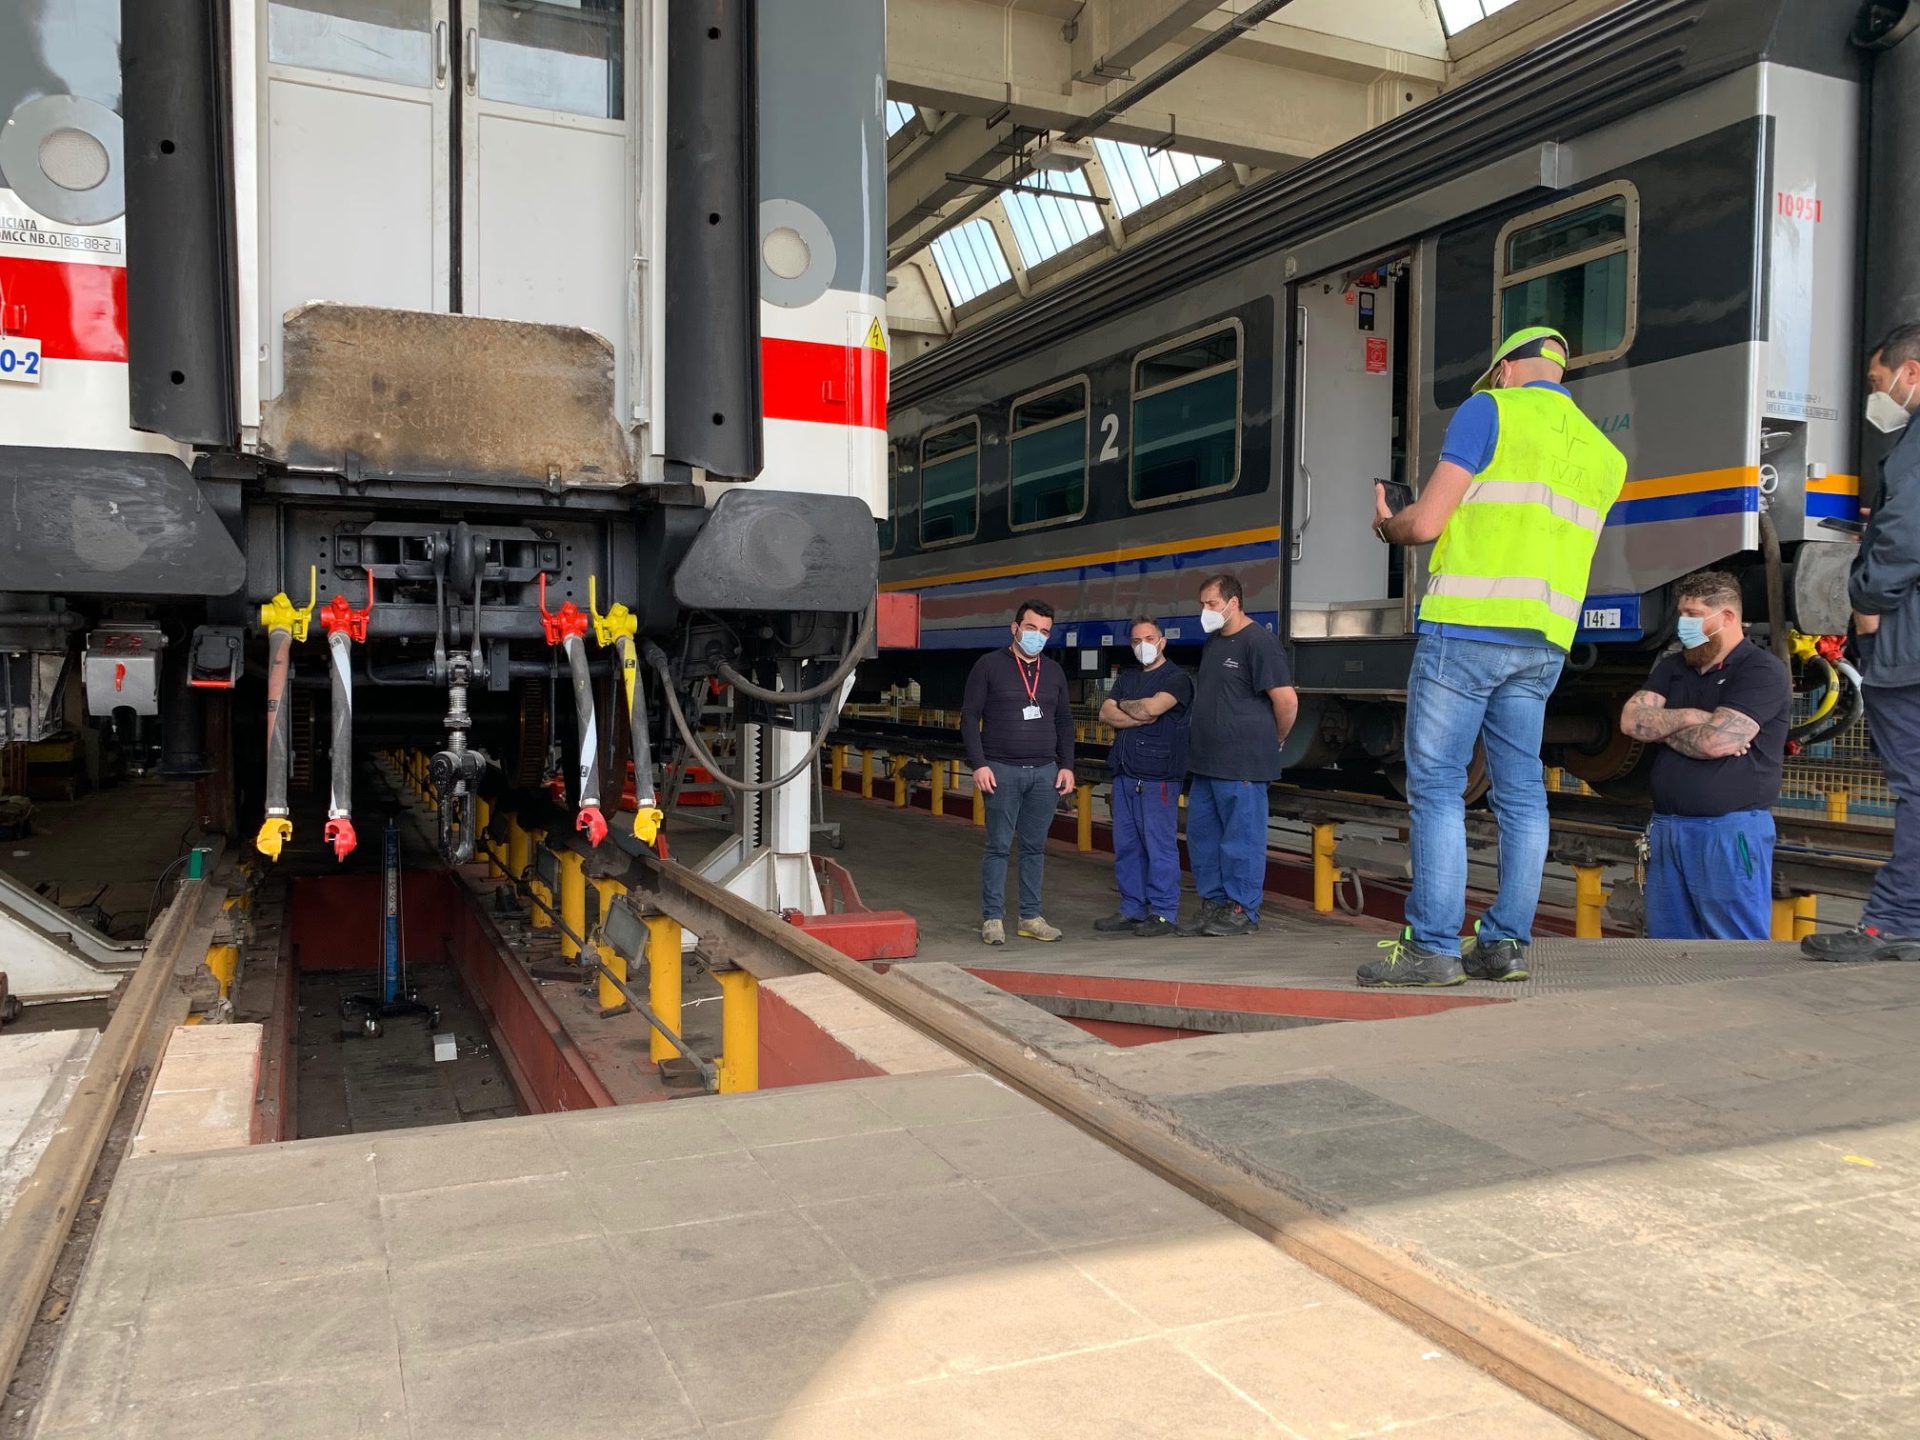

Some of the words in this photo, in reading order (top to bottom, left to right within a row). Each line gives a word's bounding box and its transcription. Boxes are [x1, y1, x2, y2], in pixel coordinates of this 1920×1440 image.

[1777, 191, 1822, 224] 10951
[0, 216, 37, 230] ICIATA
[0, 229, 26, 243] MCC
[1100, 413, 1119, 462] 2
[1586, 611, 1604, 627] 14t
